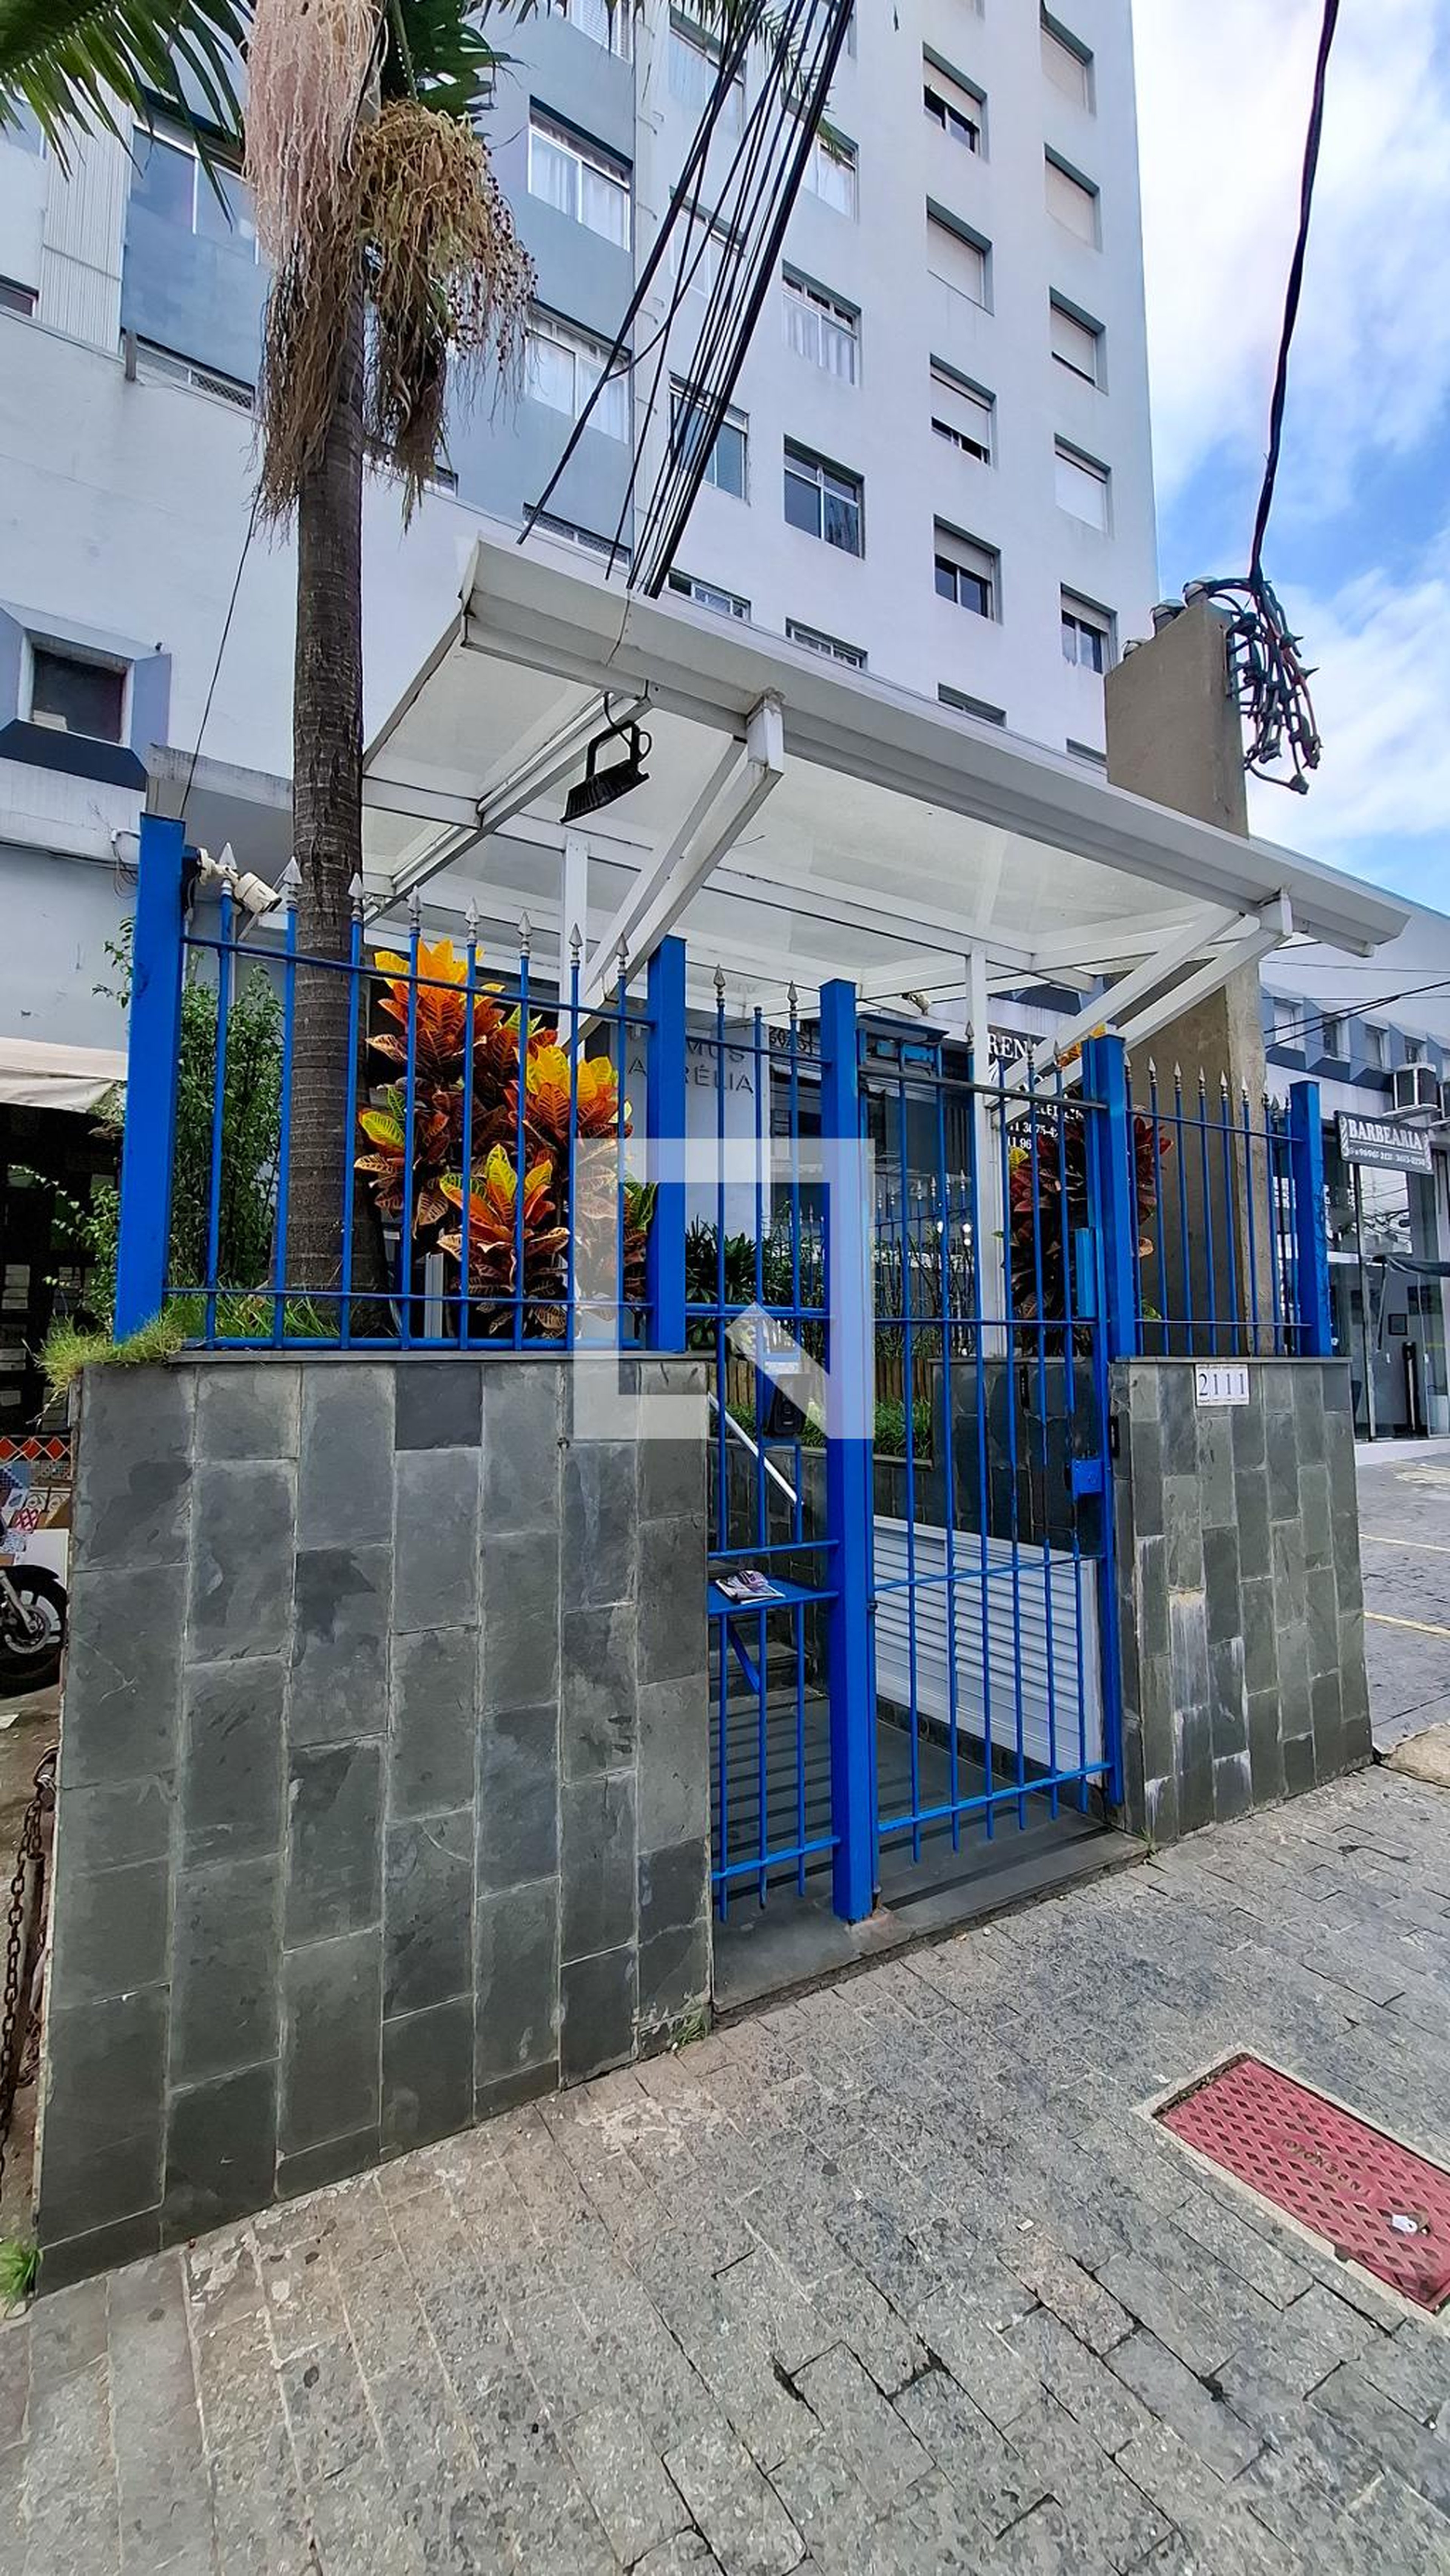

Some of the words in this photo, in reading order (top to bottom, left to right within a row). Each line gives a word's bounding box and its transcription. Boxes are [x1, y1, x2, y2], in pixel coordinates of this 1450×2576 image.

[628, 1057, 754, 1094] AÉLIA
[1348, 1118, 1423, 1150] BARBEARIA
[1199, 1373, 1244, 1396] 2111
